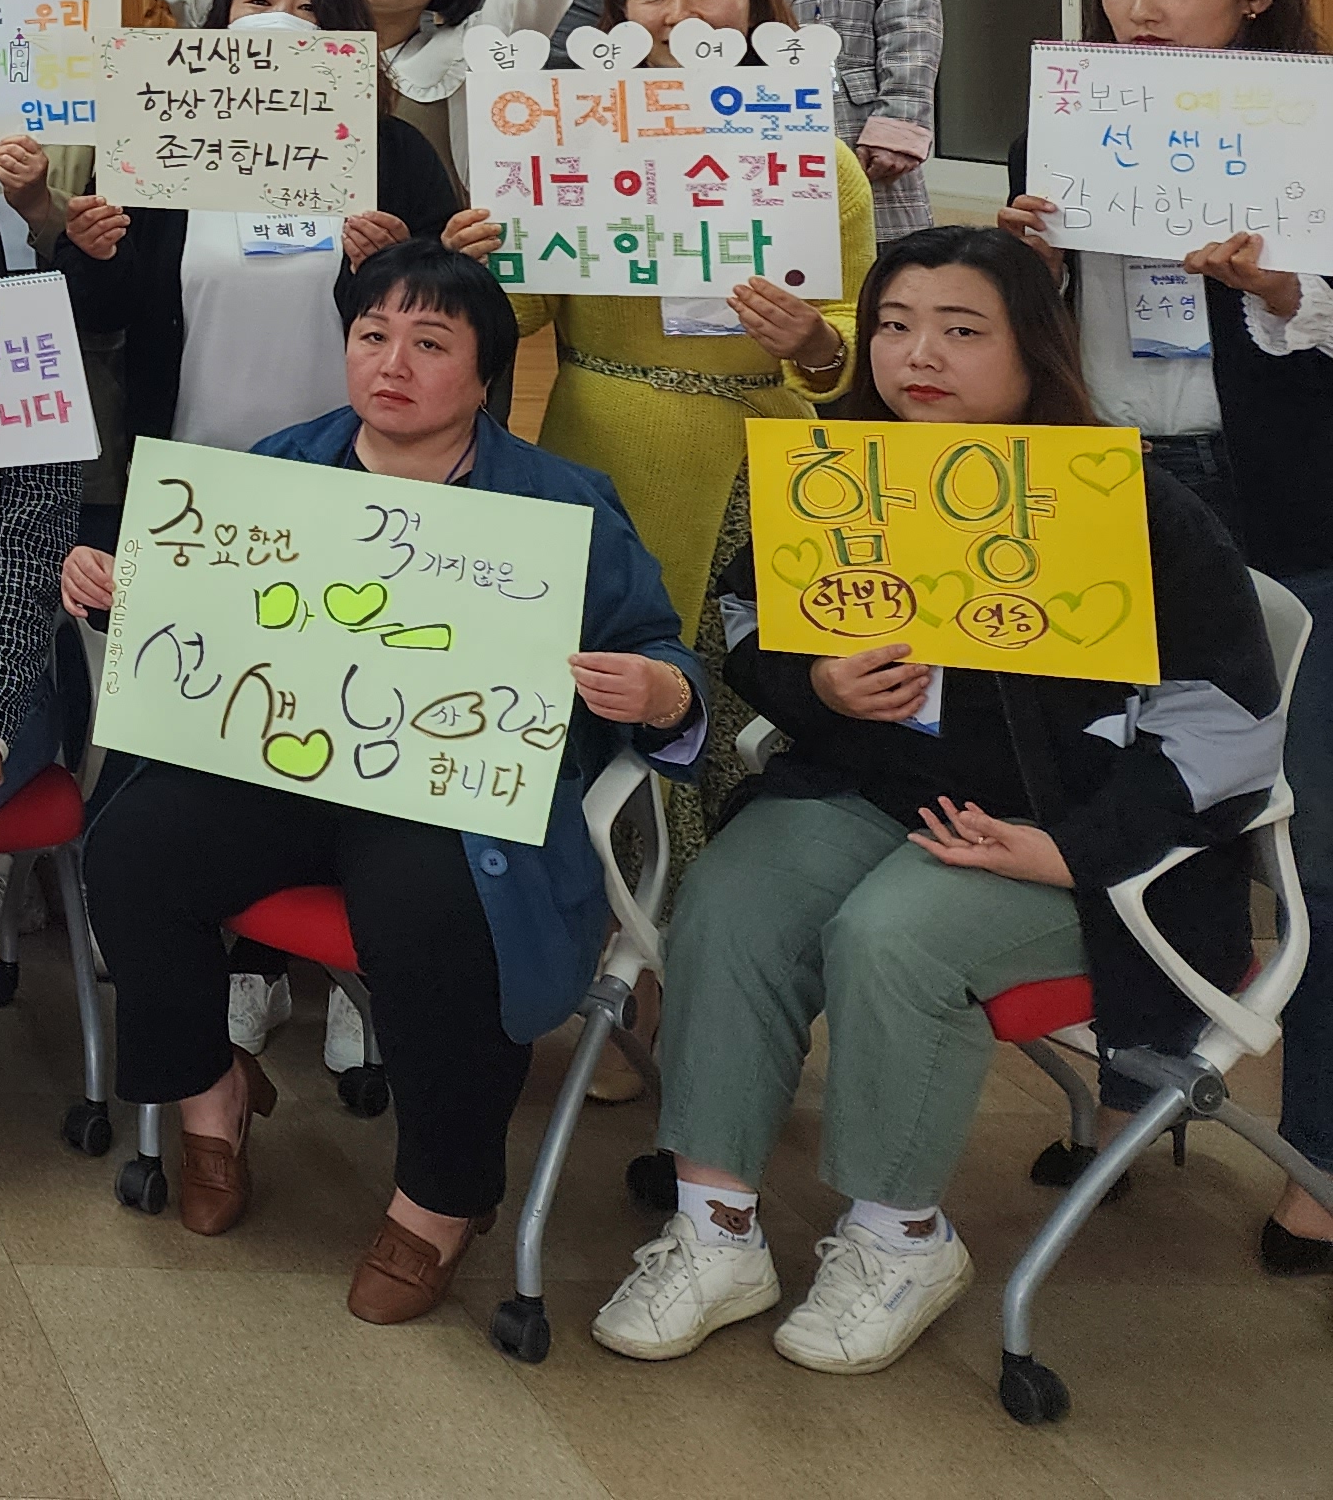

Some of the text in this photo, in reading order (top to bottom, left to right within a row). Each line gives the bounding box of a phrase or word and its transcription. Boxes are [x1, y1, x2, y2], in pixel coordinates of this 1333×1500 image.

[24, 0, 90, 31] 우리
[168, 37, 280, 74] 선생님,
[137, 82, 335, 121] 항상 감사드리고
[491, 77, 830, 146] 어제도 오늘도
[1047, 66, 1155, 115] 꽃보다
[156, 135, 329, 176] 존경합니다
[1101, 124, 1247, 176] 선생님
[273, 187, 321, 210] 주상초
[495, 152, 833, 207] 지금 이 순간도
[786, 425, 1059, 590] 함양
[811, 575, 1035, 638] 학부모 일동
[429, 752, 527, 807] 합니다
